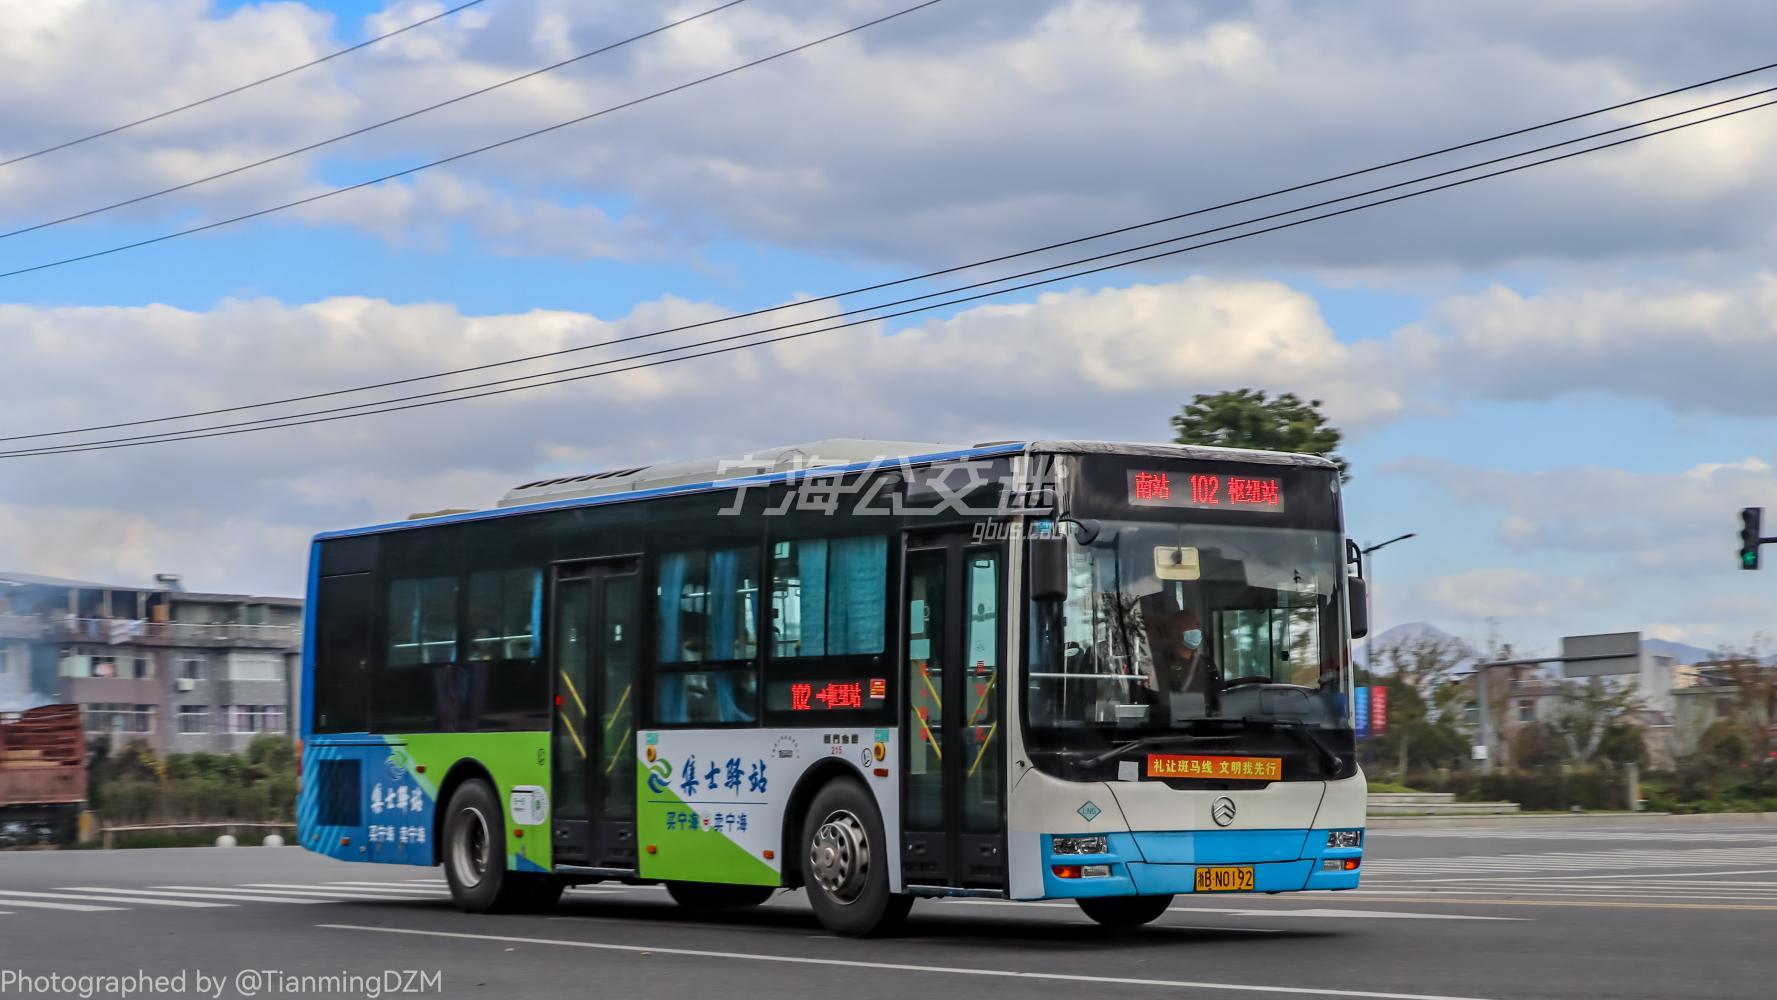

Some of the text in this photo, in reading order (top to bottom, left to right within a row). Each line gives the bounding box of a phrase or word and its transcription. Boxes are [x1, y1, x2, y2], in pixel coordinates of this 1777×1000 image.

[1135, 471, 1279, 506] 南站 102 枢纽站
[1153, 758, 1277, 776] 礼让斑马线 文明我先行
